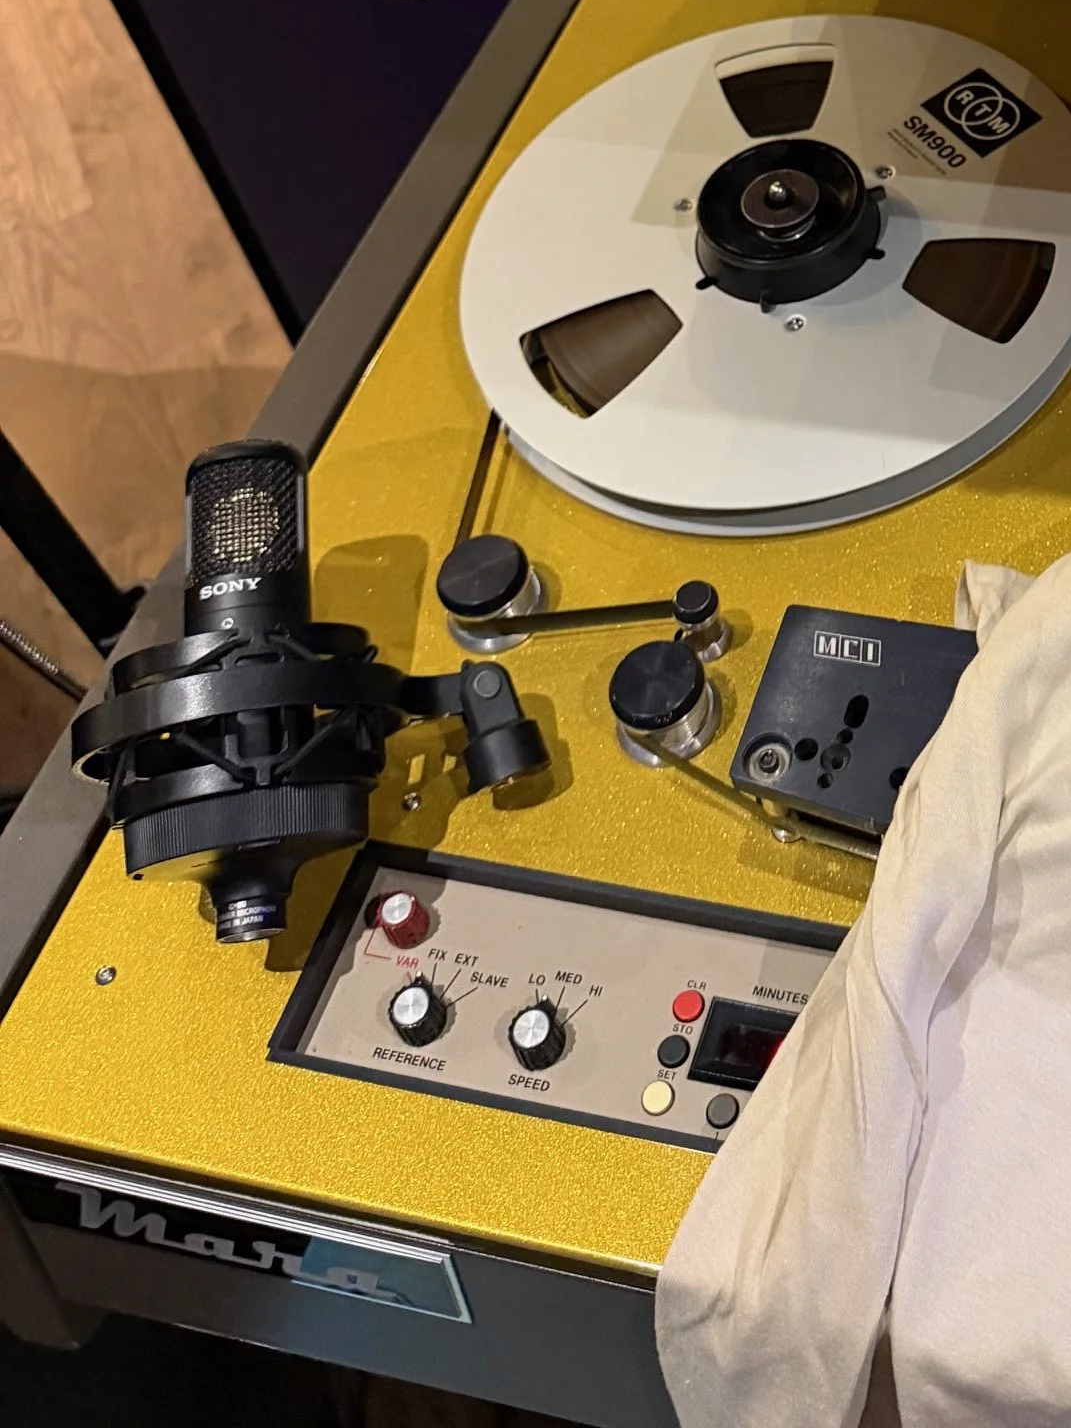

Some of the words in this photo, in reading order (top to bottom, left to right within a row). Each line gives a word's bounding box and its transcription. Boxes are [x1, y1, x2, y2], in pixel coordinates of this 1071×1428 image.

[955, 90, 1011, 134] RTM
[904, 116, 967, 168] SM900
[199, 577, 262, 600] SONY
[818, 635, 874, 661] MCI
[242, 915, 264, 925] JAPAN
[396, 955, 419, 968] VAR
[428, 948, 448, 961] FIX
[455, 953, 479, 968] EXT
[470, 972, 510, 988] SLAVE
[528, 973, 546, 985] LO
[554, 971, 583, 985] MED
[687, 979, 707, 991] CLR
[589, 985, 603, 997] HI
[752, 985, 810, 1005] MINUTES
[672, 1023, 693, 1035] STO
[372, 1047, 447, 1071] REFERENCE
[656, 1069, 677, 1081] SET
[508, 1073, 551, 1092] SPEED
